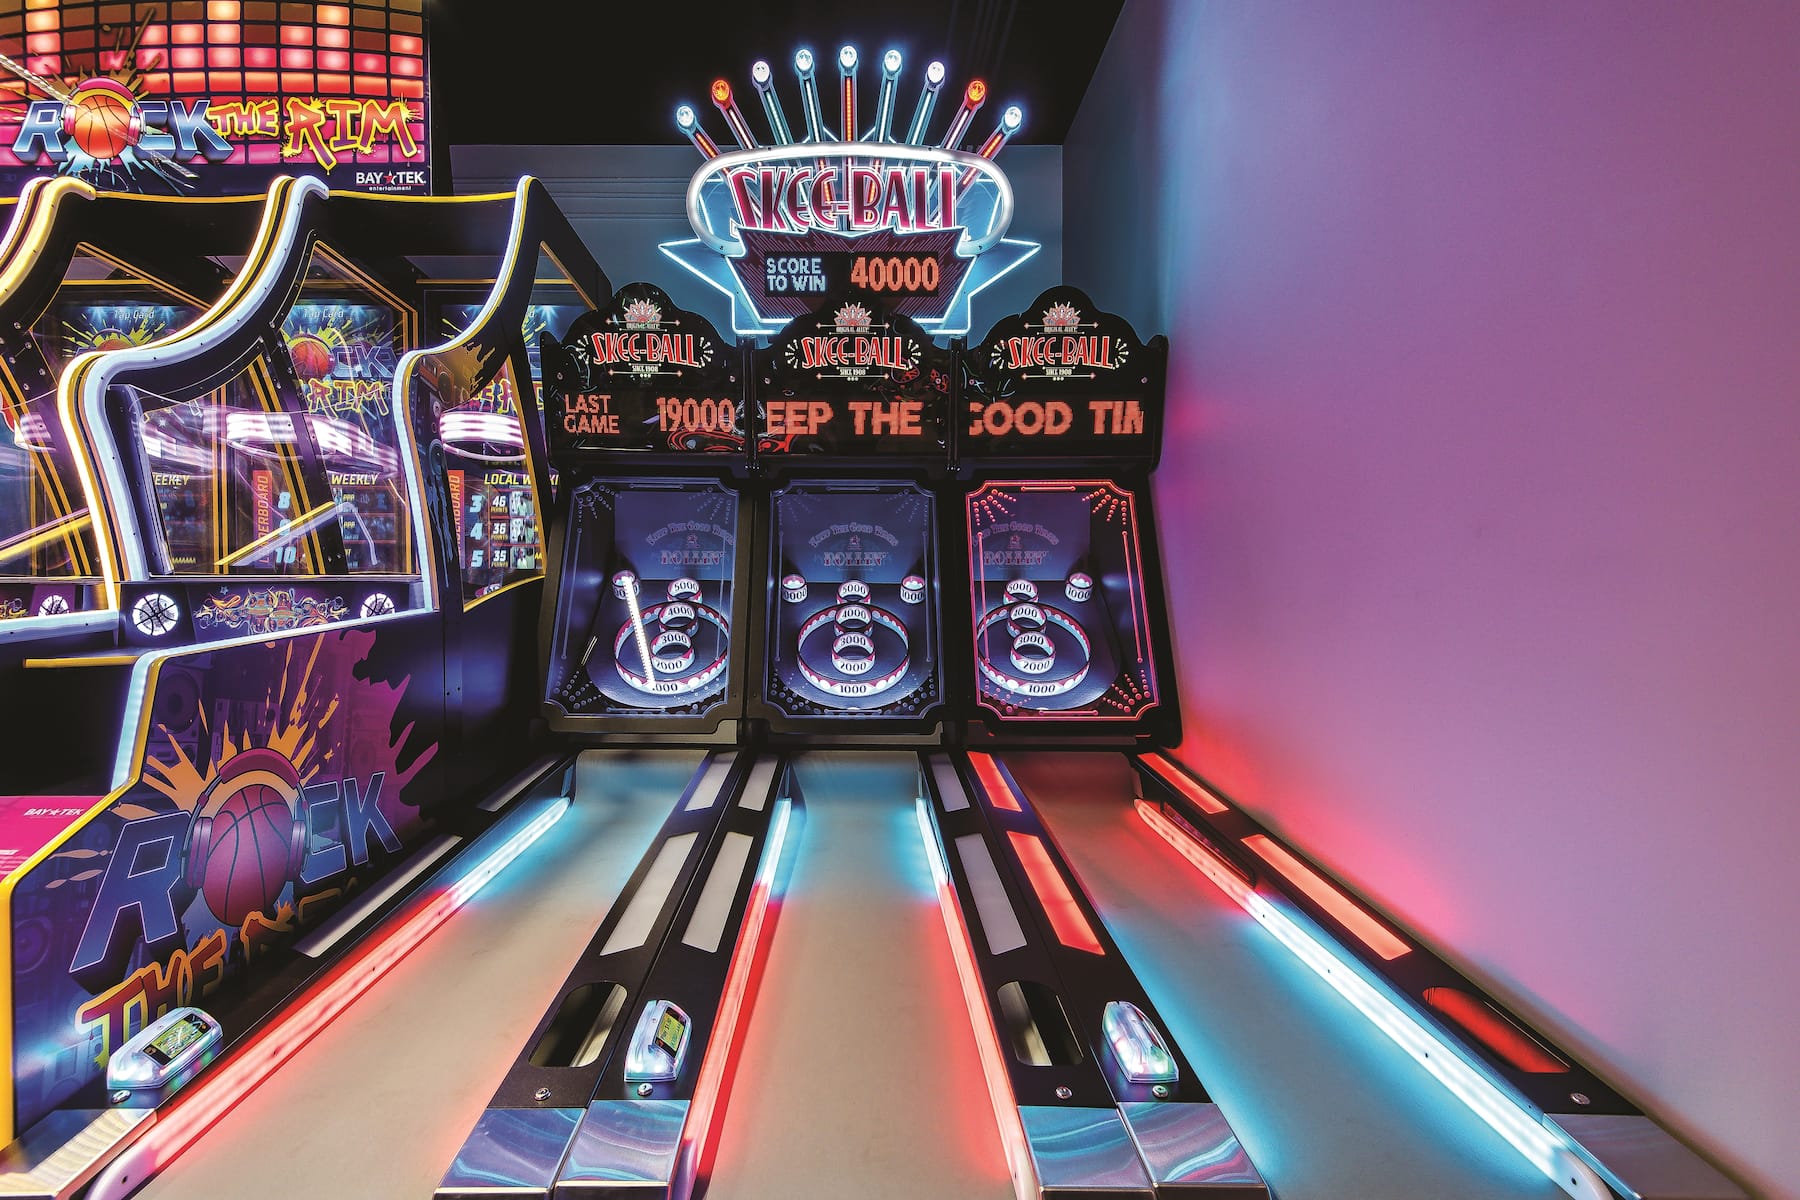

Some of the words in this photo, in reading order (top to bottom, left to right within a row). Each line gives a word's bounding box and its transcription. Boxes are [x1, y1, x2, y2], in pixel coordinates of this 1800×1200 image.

[206, 100, 280, 137] THE
[286, 96, 418, 167] RIM
[355, 172, 384, 184] BAY
[729, 166, 971, 239] SKEE-BALL
[766, 257, 822, 275] SCORE
[850, 256, 939, 292] 40000
[766, 275, 787, 292] TO
[791, 275, 826, 292] WIN
[592, 332, 703, 368] SKEE-BALL
[801, 336, 911, 370] SKEE-BALL
[1007, 335, 1116, 369] SKEE-BALL
[564, 394, 612, 414] LAST
[656, 397, 736, 433] 19000
[766, 401, 834, 435] EEP
[848, 401, 924, 435] THE
[563, 415, 620, 434] GAME
[331, 473, 378, 486] WEEKLY
[484, 473, 520, 485] LOCAL
[278, 491, 291, 509] 8
[469, 494, 483, 513] 3
[492, 495, 507, 508] 46
[470, 522, 483, 540] 4
[493, 522, 507, 535] 36
[275, 546, 296, 564] 10
[470, 549, 484, 568] 5
[493, 549, 507, 562] 35
[673, 581, 698, 592] 5000
[842, 583, 867, 595] 5000
[1008, 583, 1032, 593] 5000
[667, 606, 693, 617] 4000
[841, 609, 867, 619] 4000
[1013, 607, 1038, 618] 4000
[661, 632, 688, 644] 3000
[840, 635, 867, 646] 3000
[1017, 634, 1044, 646] 3000
[840, 661, 867, 672] 2000
[1023, 661, 1050, 672] 2000
[840, 684, 867, 694] 1000
[1028, 684, 1056, 694] 1000
[23, 808, 52, 816] BAY
